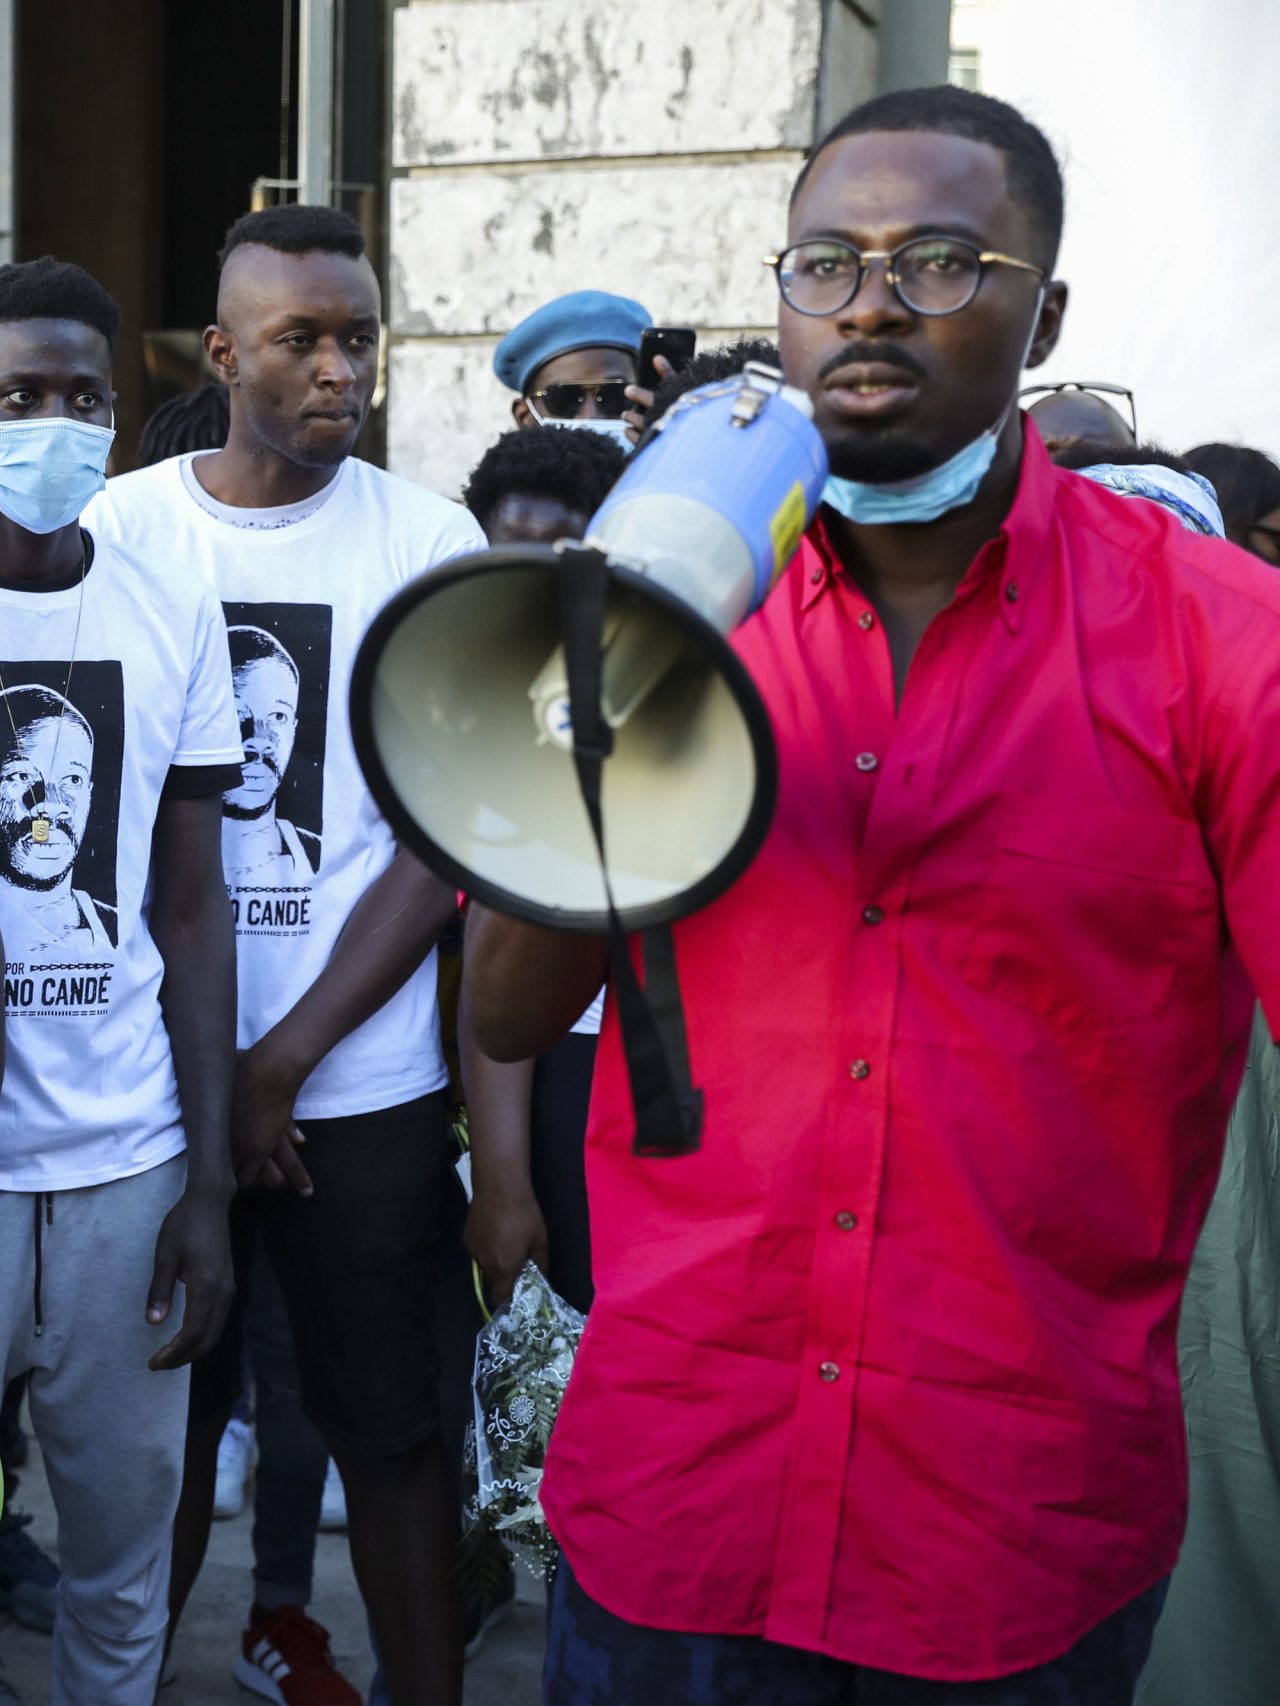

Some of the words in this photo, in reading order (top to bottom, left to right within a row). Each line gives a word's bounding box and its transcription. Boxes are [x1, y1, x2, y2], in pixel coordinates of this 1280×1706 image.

[247, 895, 310, 926] CANDÉ
[5, 963, 24, 975] POR
[41, 972, 112, 1006] CANDÉ
